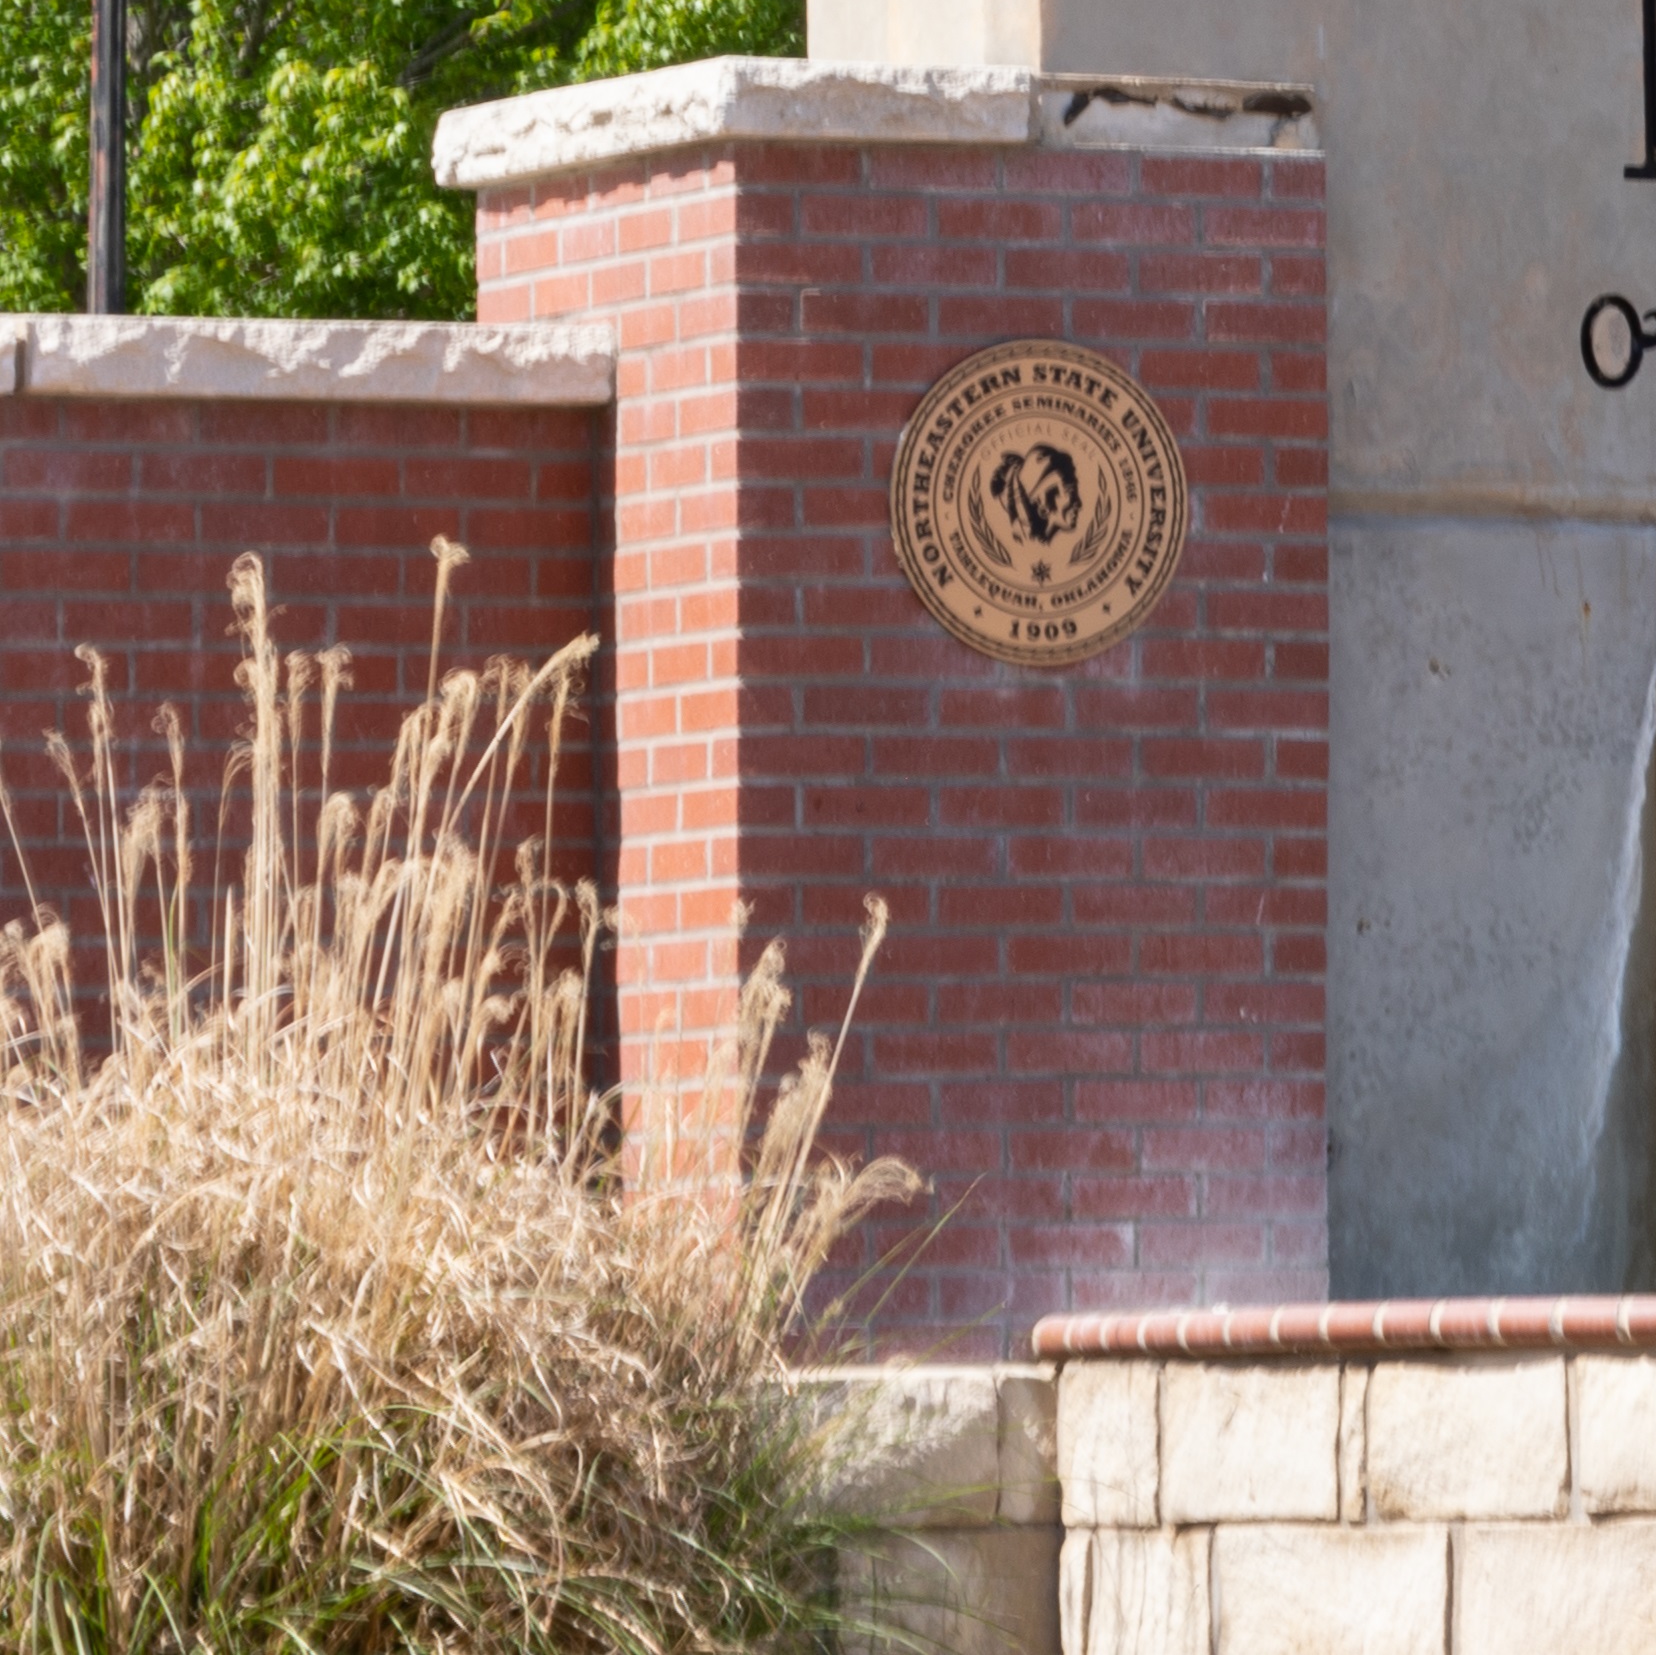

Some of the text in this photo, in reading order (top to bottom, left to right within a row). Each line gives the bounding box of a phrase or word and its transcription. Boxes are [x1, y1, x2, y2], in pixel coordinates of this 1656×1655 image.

[914, 363, 1167, 596] NORTHEASTERN STATE UNIVERSITY
[942, 405, 1006, 504] CHEROKEE
[1012, 397, 1120, 452] SEMINARIES
[1050, 529, 1133, 608] OKLAHOMA
[1008, 619, 1078, 641] 1909
